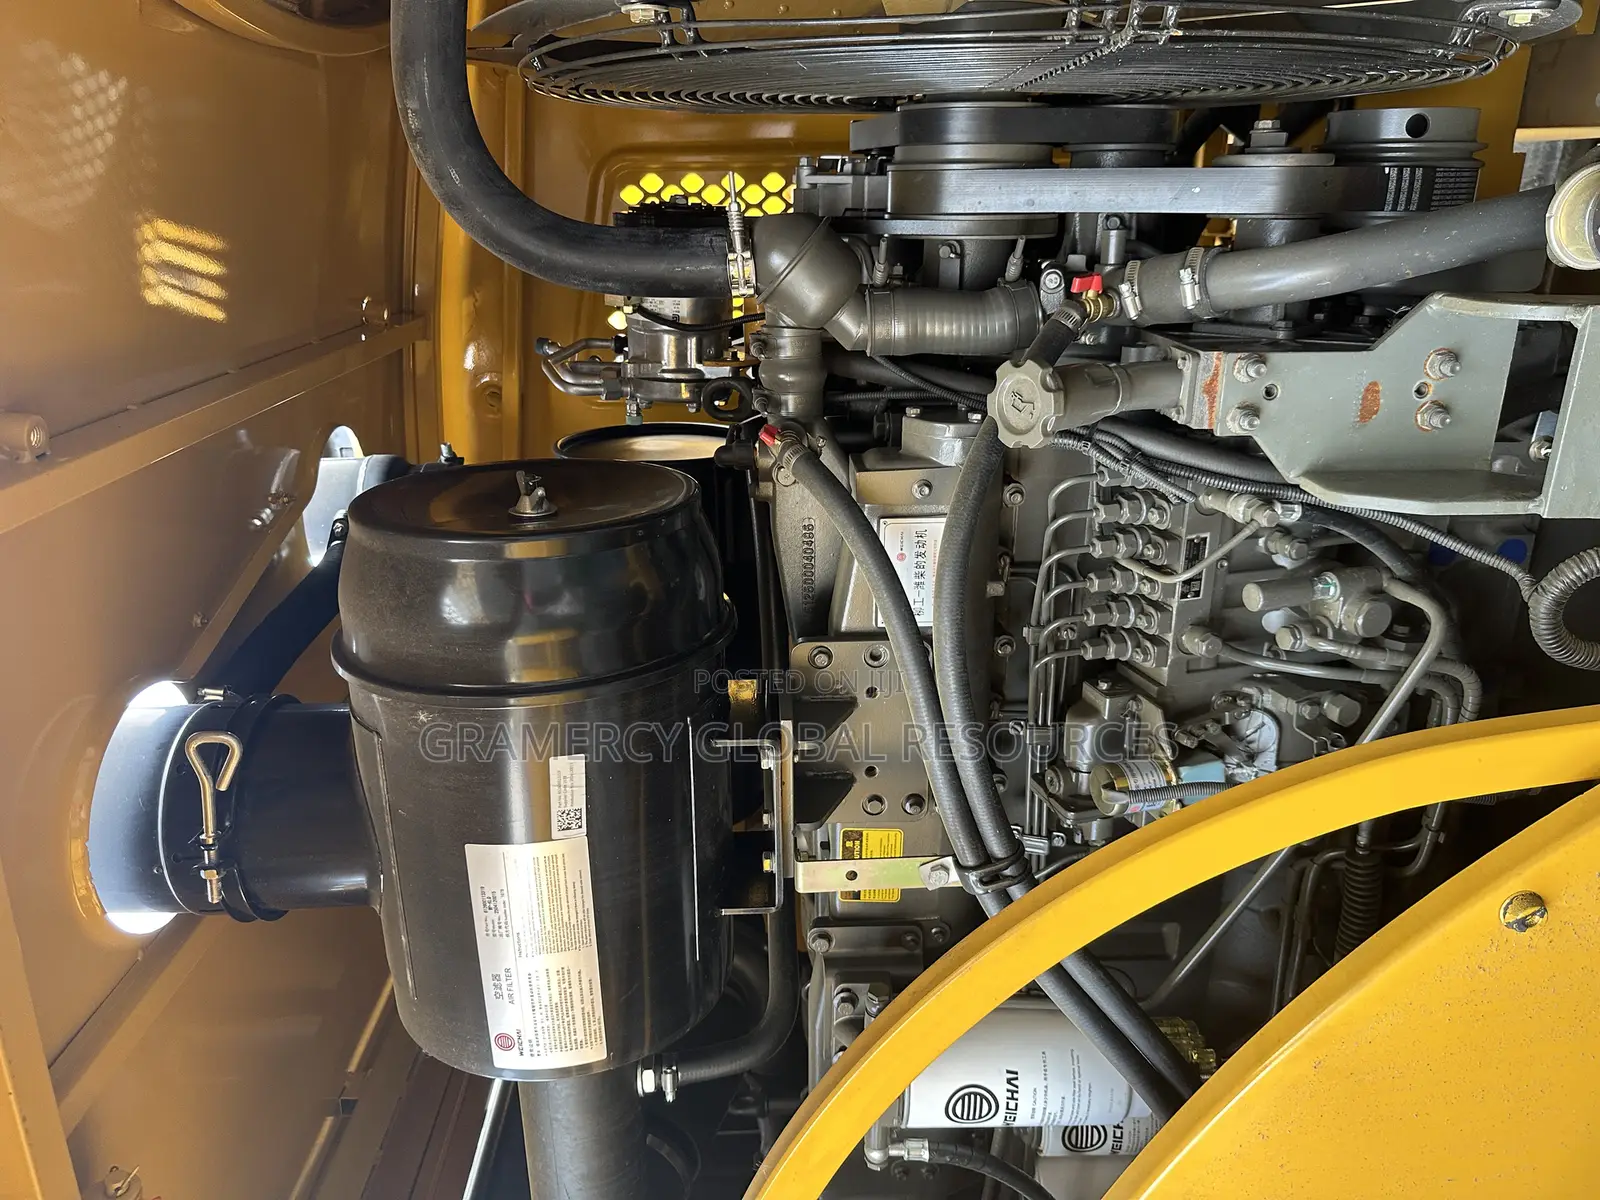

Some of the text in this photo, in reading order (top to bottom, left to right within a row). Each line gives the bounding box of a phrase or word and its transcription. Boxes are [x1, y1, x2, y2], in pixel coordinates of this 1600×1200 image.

[853, 840, 861, 858] UTION
[491, 973, 504, 1000] 空滤器
[504, 967, 516, 1005] AIR FILTER
